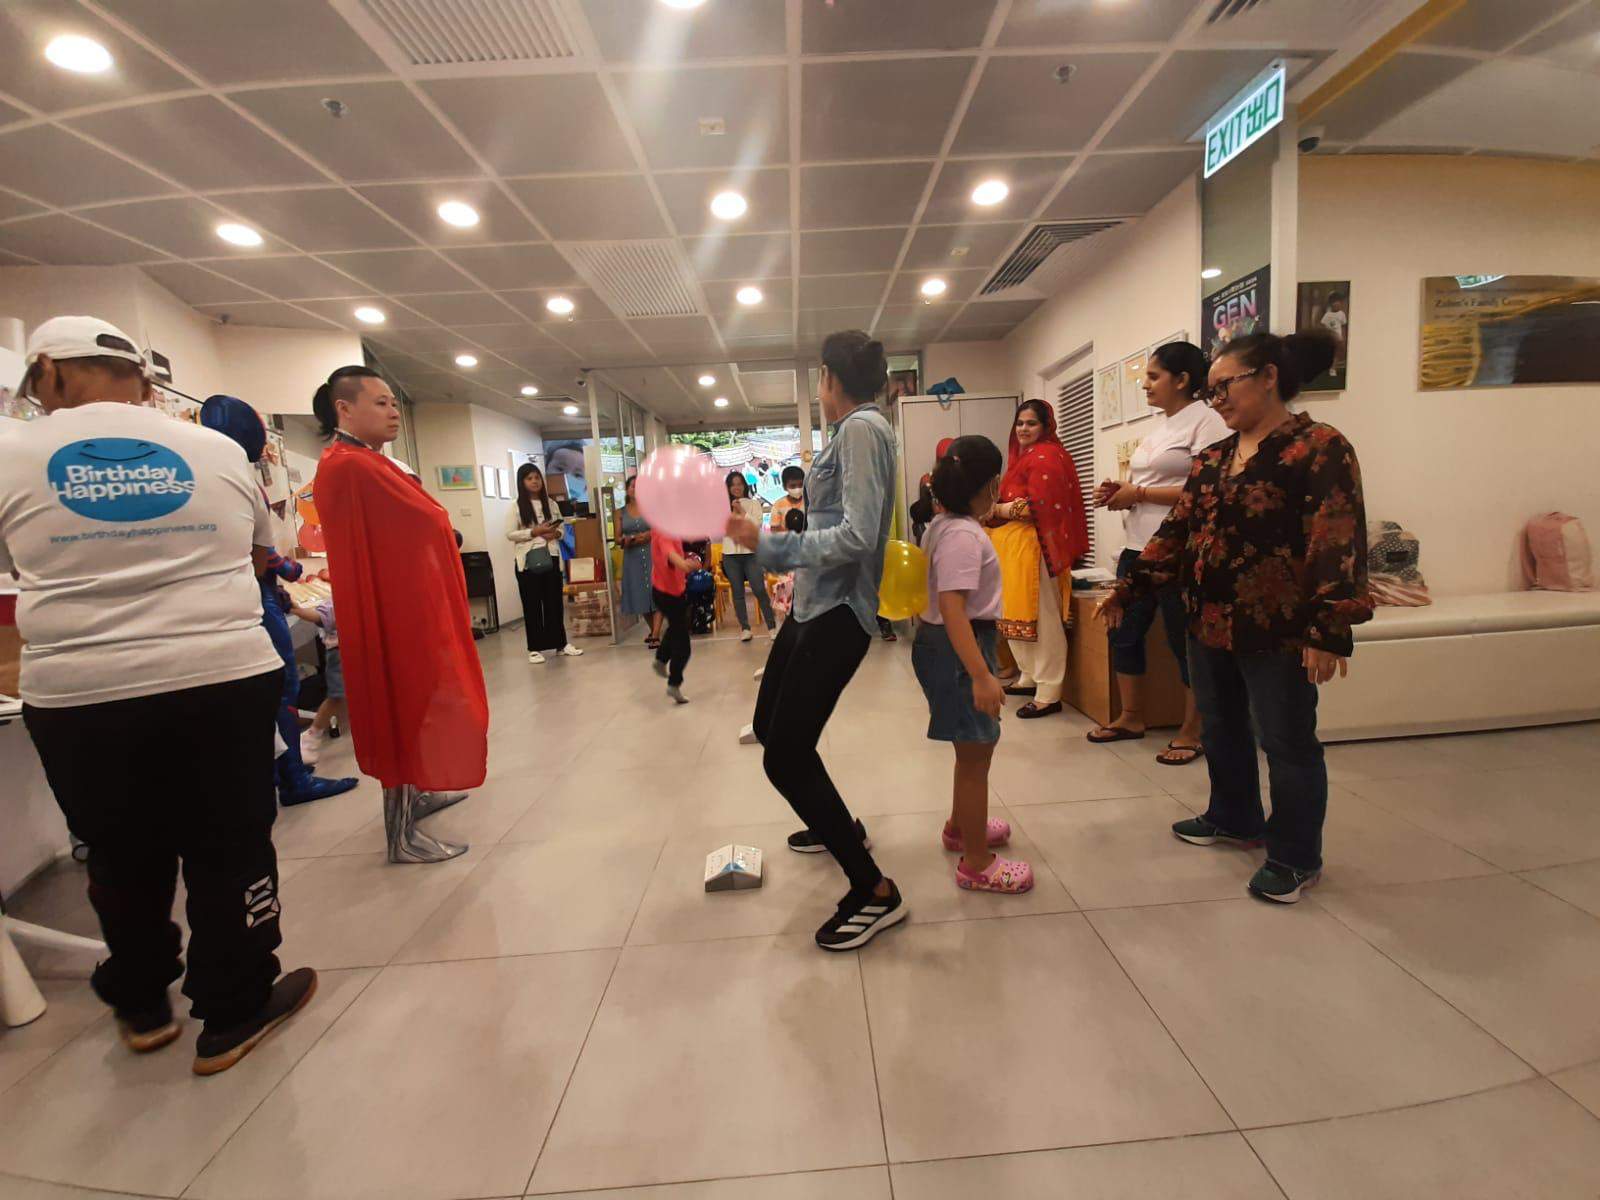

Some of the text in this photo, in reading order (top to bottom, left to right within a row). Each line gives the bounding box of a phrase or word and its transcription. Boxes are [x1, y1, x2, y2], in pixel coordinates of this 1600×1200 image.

[1207, 77, 1281, 172] EXIT 出口
[1213, 288, 1258, 329] GEN
[65, 464, 177, 484] Birthday
[51, 479, 197, 502] Happiness
[50, 522, 217, 544] www.birthdayhappiness.org
